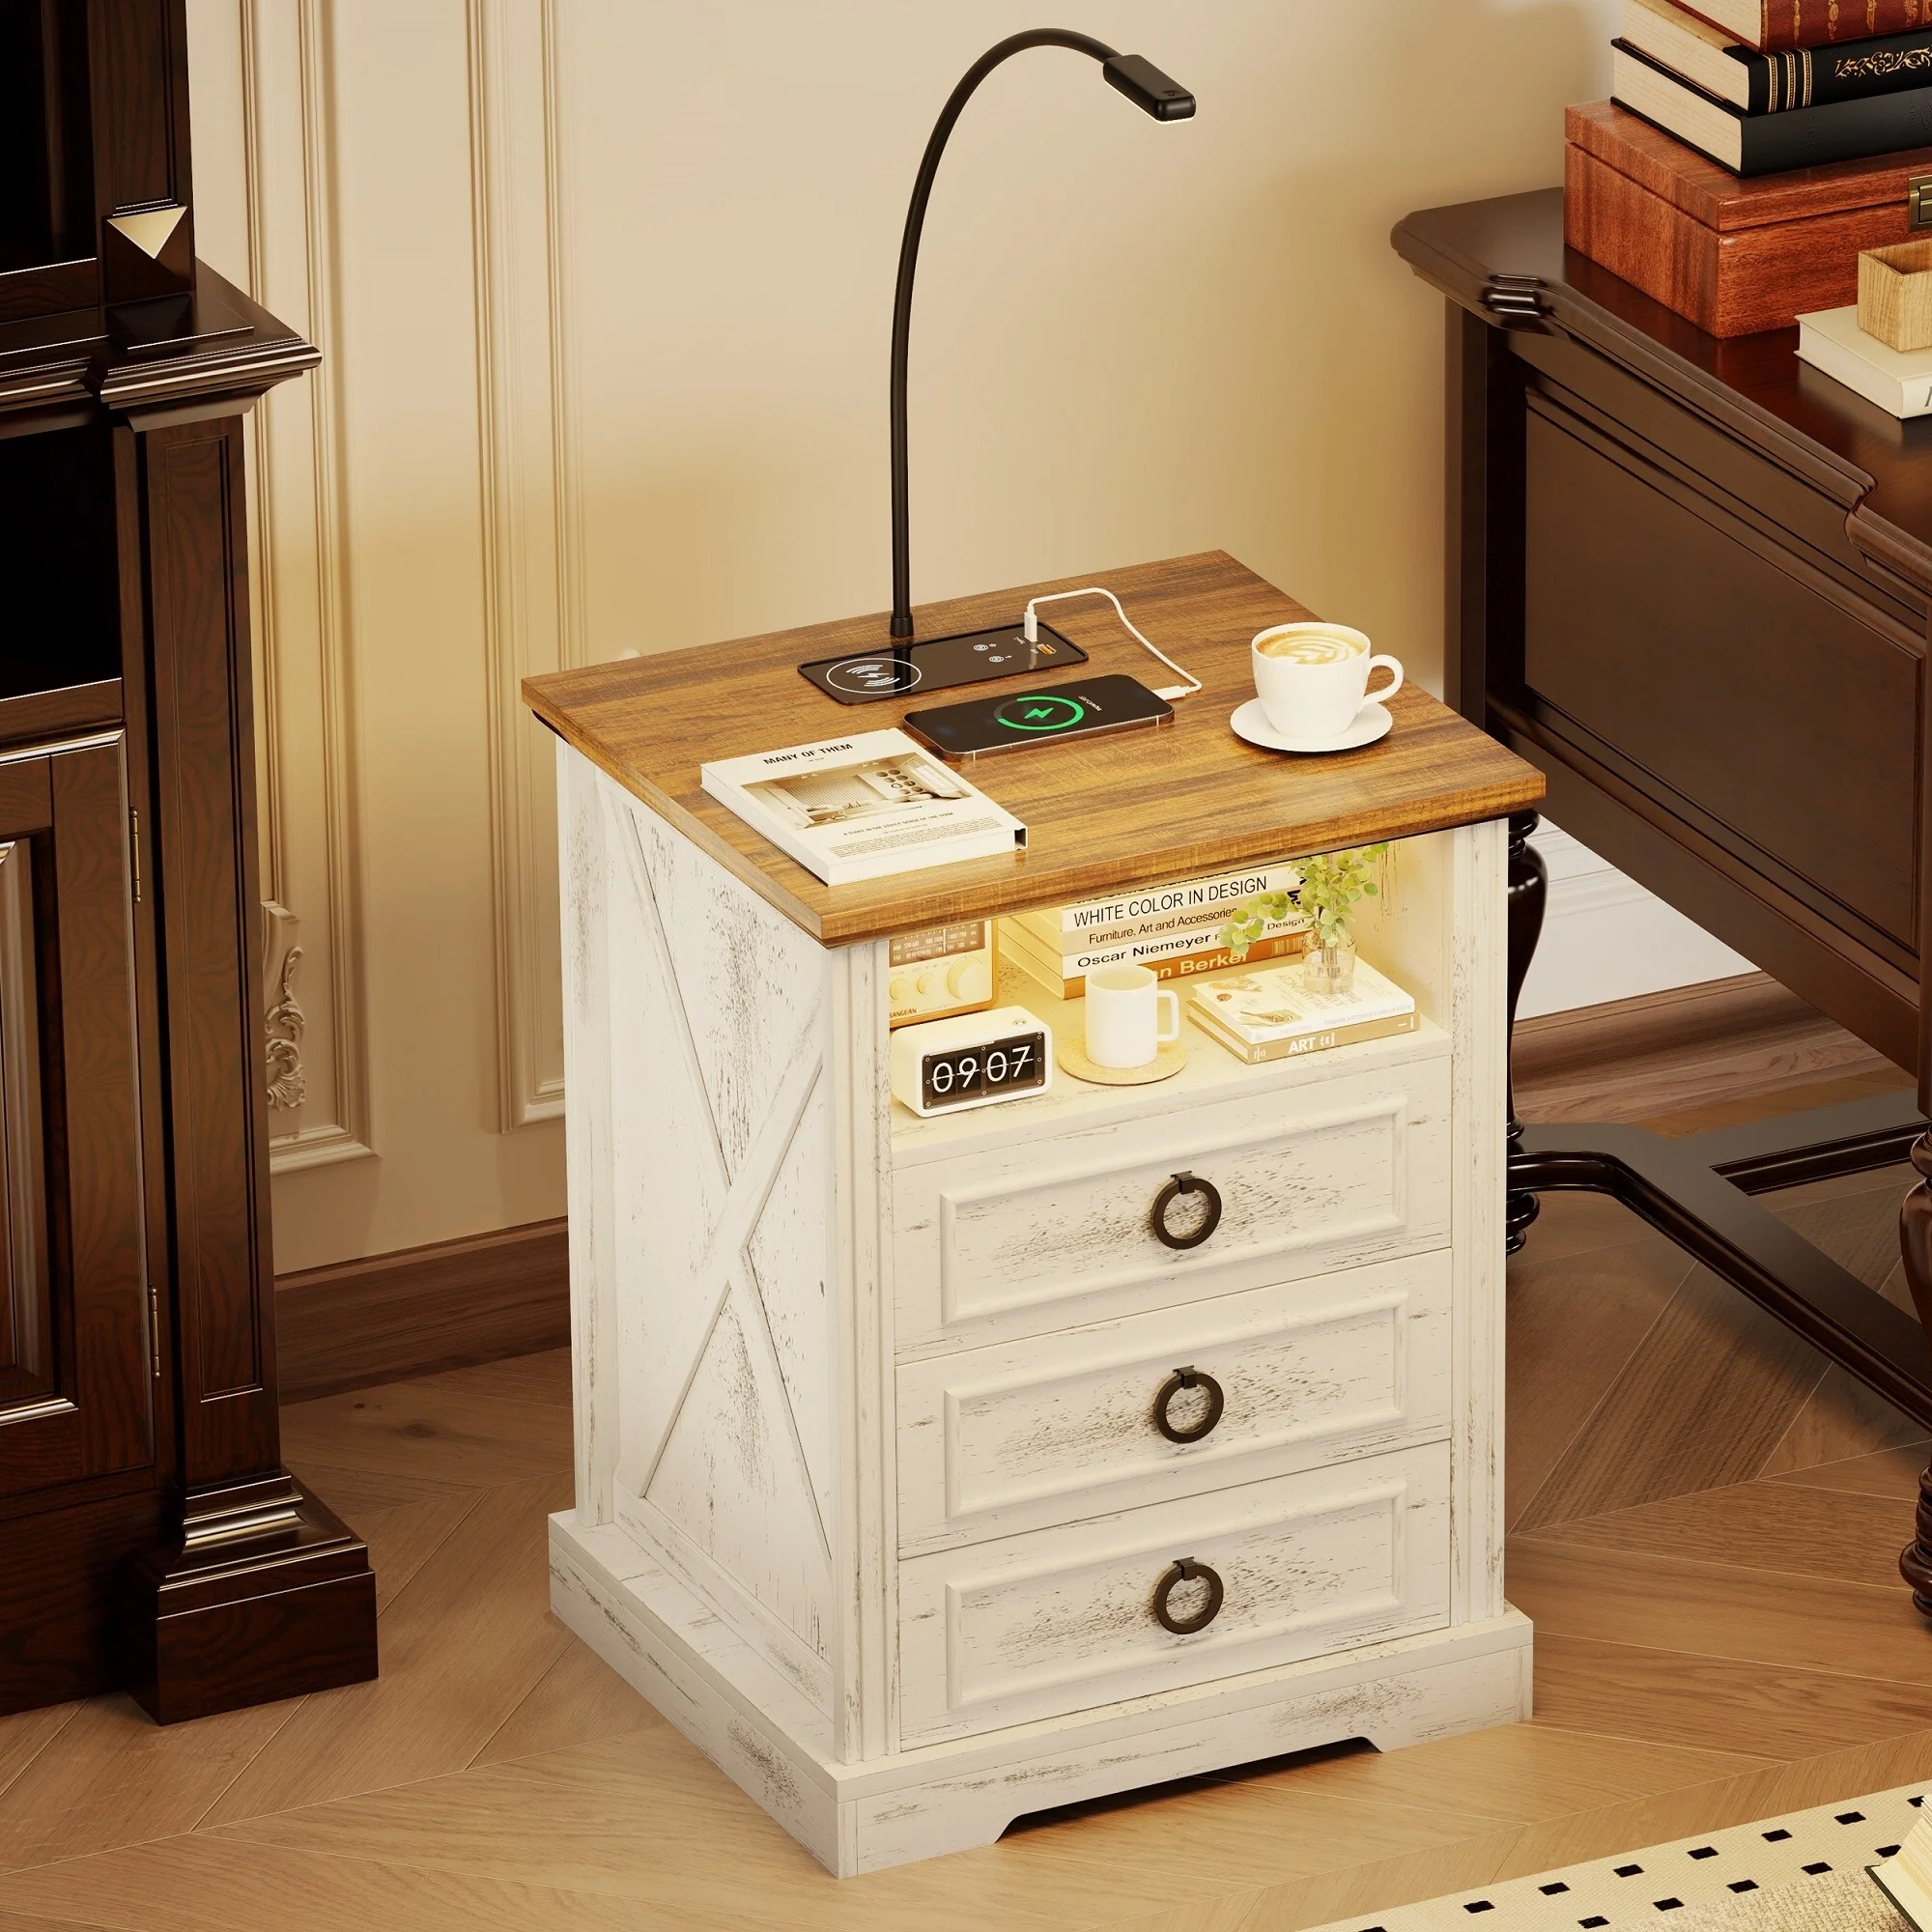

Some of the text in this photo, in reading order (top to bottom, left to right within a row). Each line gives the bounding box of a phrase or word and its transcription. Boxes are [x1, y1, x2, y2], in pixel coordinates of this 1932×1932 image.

[763, 753, 798, 764] MANY
[818, 743, 853, 753] THEM
[1073, 903, 1124, 927] WHITE
[1128, 893, 1184, 917] COLOR
[1188, 888, 1204, 905] IN
[1208, 875, 1267, 901] DESIGN
[1138, 923, 1153, 935] Art
[1155, 918, 1176, 931] and
[1077, 950, 1127, 968] Oscar
[1132, 934, 1211, 957] Niemeyer
[1289, 1037, 1315, 1054] ART
